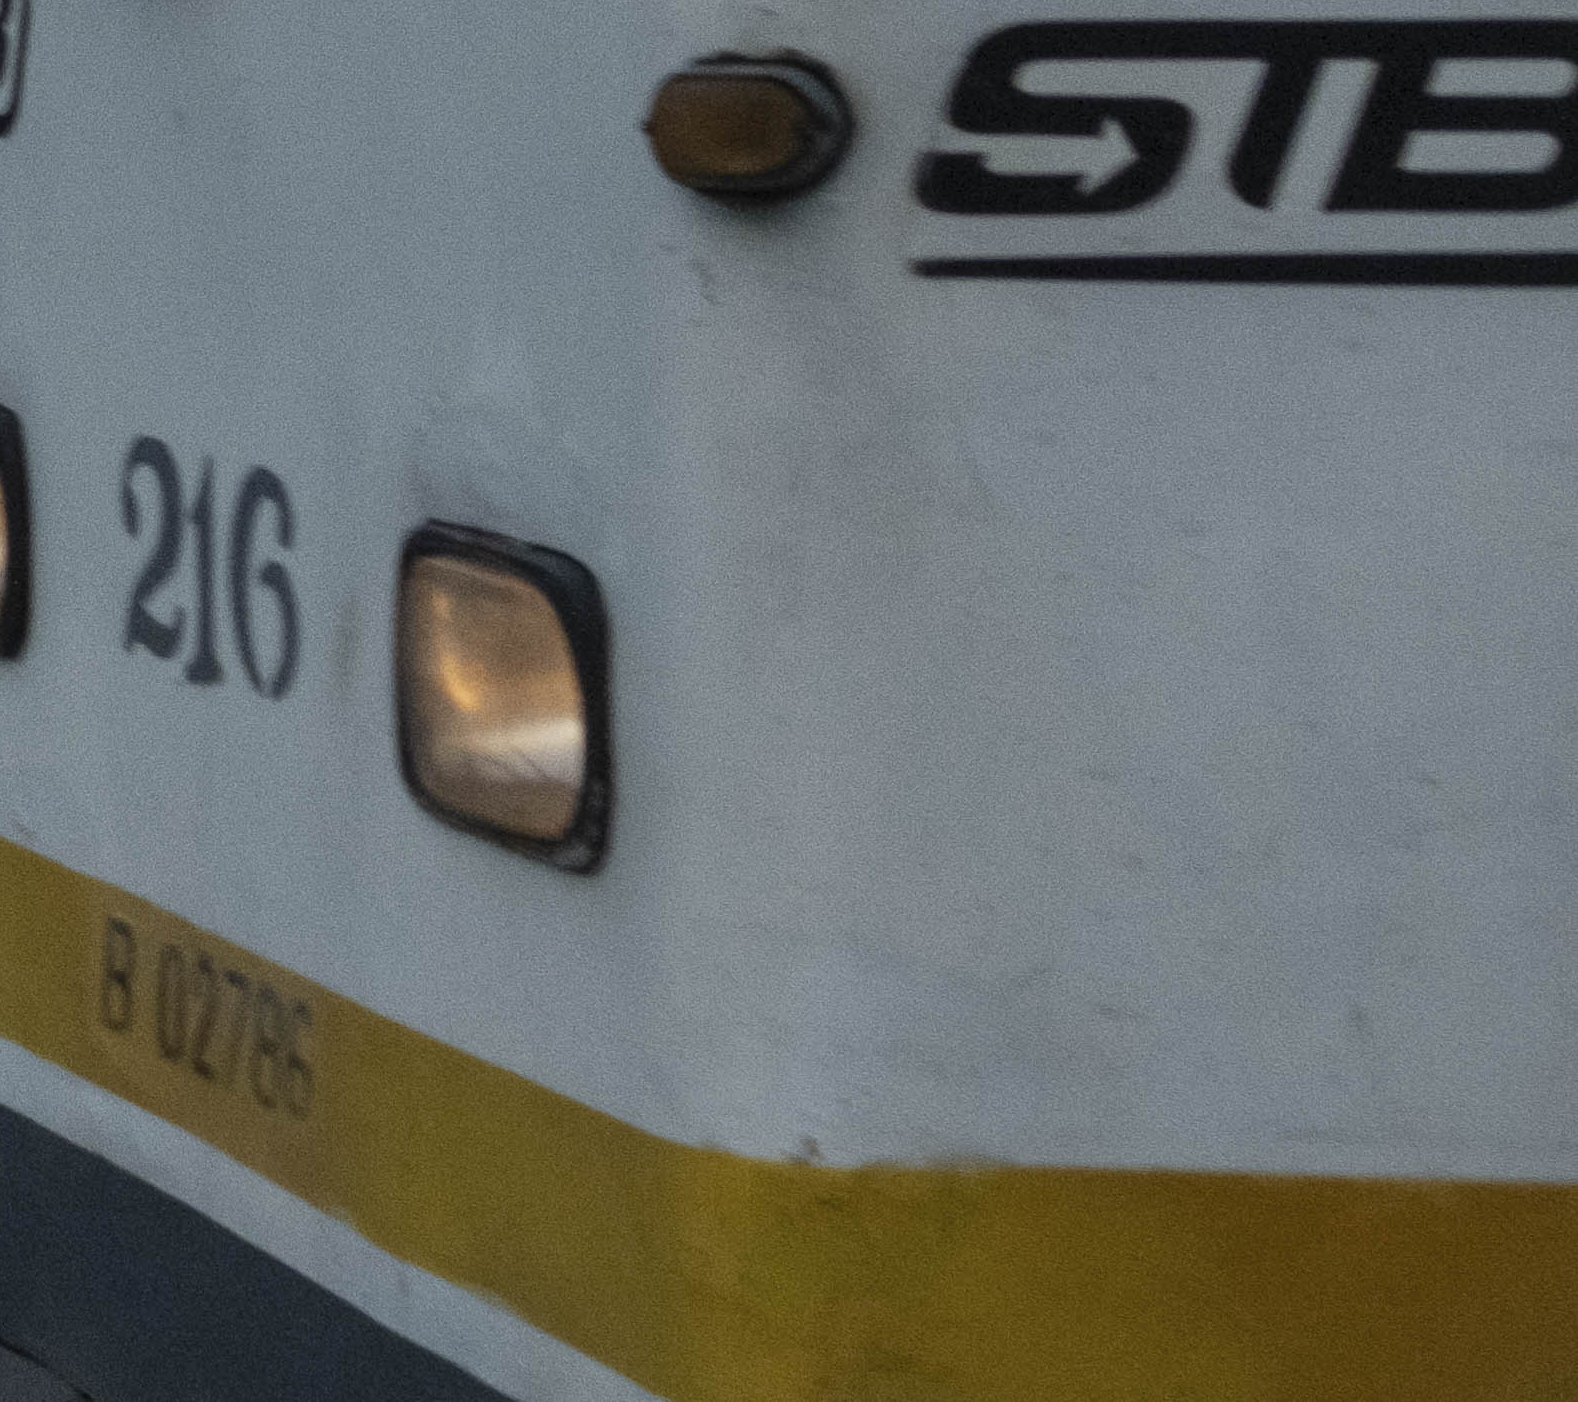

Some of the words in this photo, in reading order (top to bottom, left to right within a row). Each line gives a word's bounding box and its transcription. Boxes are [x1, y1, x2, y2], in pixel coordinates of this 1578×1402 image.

[912, 19, 1578, 216] STB
[121, 434, 301, 702] 216
[102, 915, 135, 1033] B
